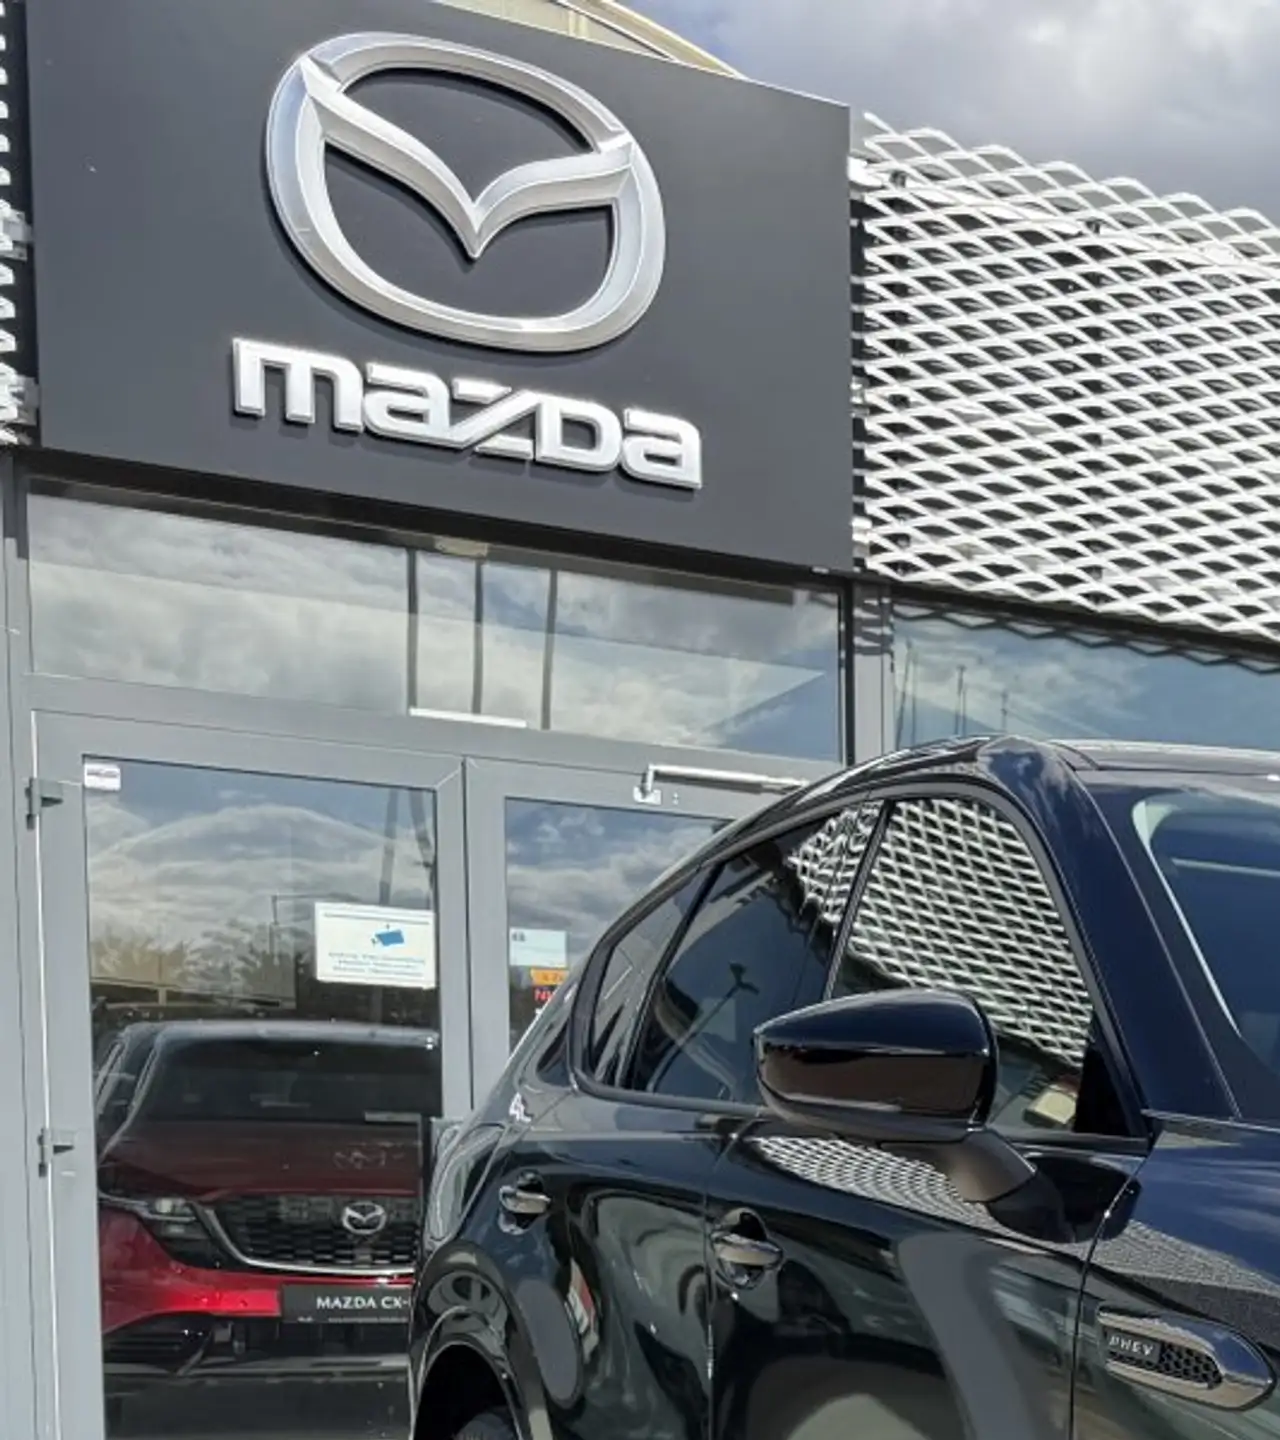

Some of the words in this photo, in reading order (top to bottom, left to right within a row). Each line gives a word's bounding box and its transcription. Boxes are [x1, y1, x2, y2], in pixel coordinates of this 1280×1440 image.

[315, 1295, 378, 1310] MAZDA
[380, 1296, 411, 1310] CX-
[1108, 1335, 1154, 1356] PHEV
